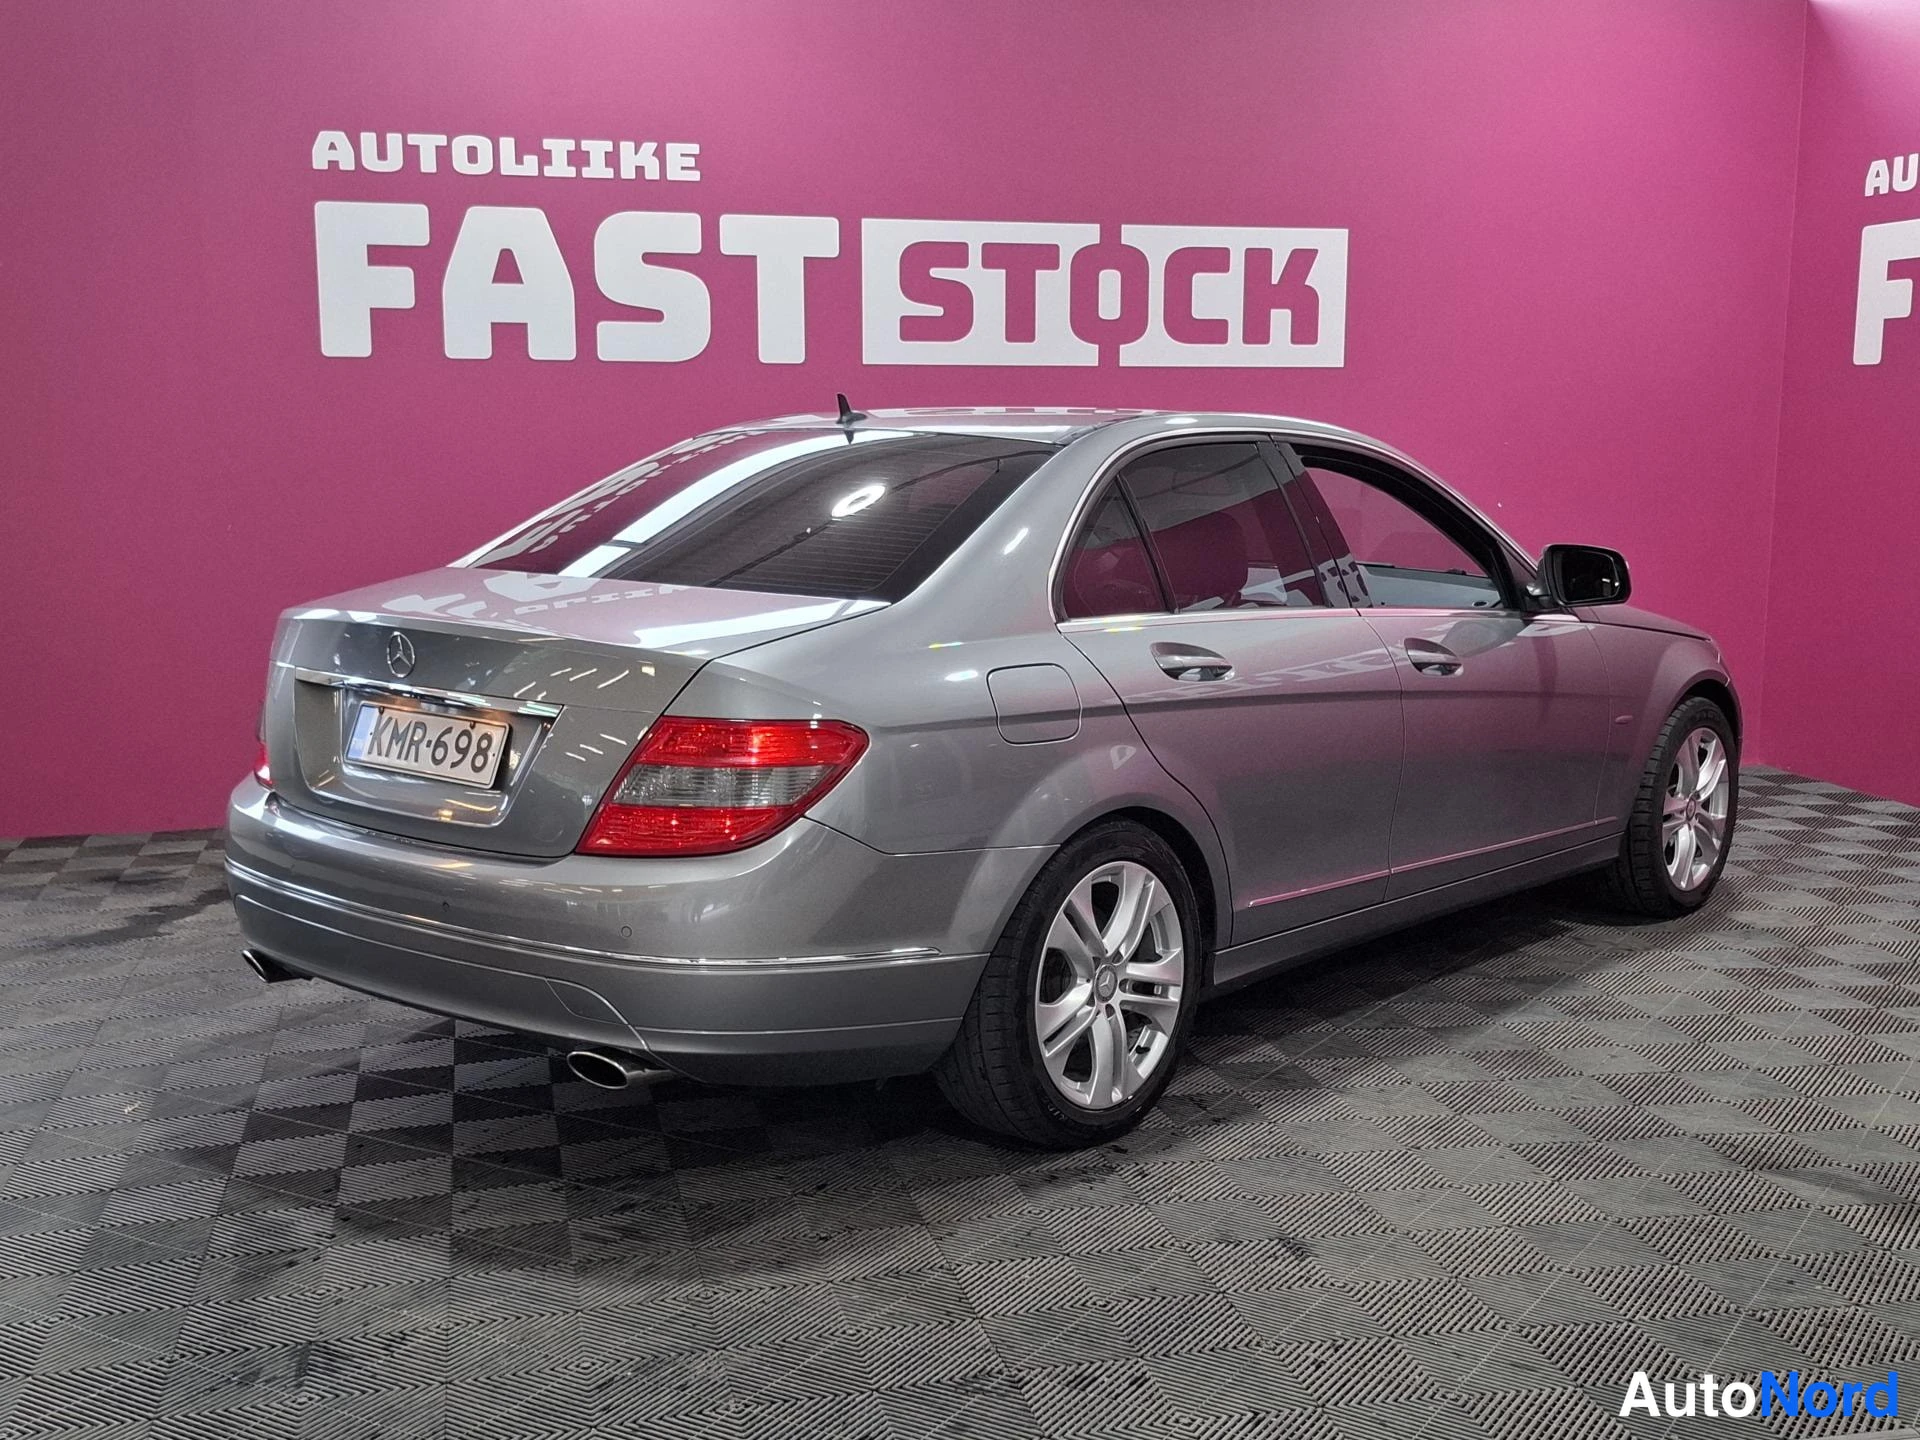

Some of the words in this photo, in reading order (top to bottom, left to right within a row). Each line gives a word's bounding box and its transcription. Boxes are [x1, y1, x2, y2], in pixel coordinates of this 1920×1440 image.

[312, 130, 700, 181] AUTOLIIKE
[315, 201, 840, 364] FAST
[899, 240, 1320, 346] STOCK
[368, 714, 493, 774] KMR-698
